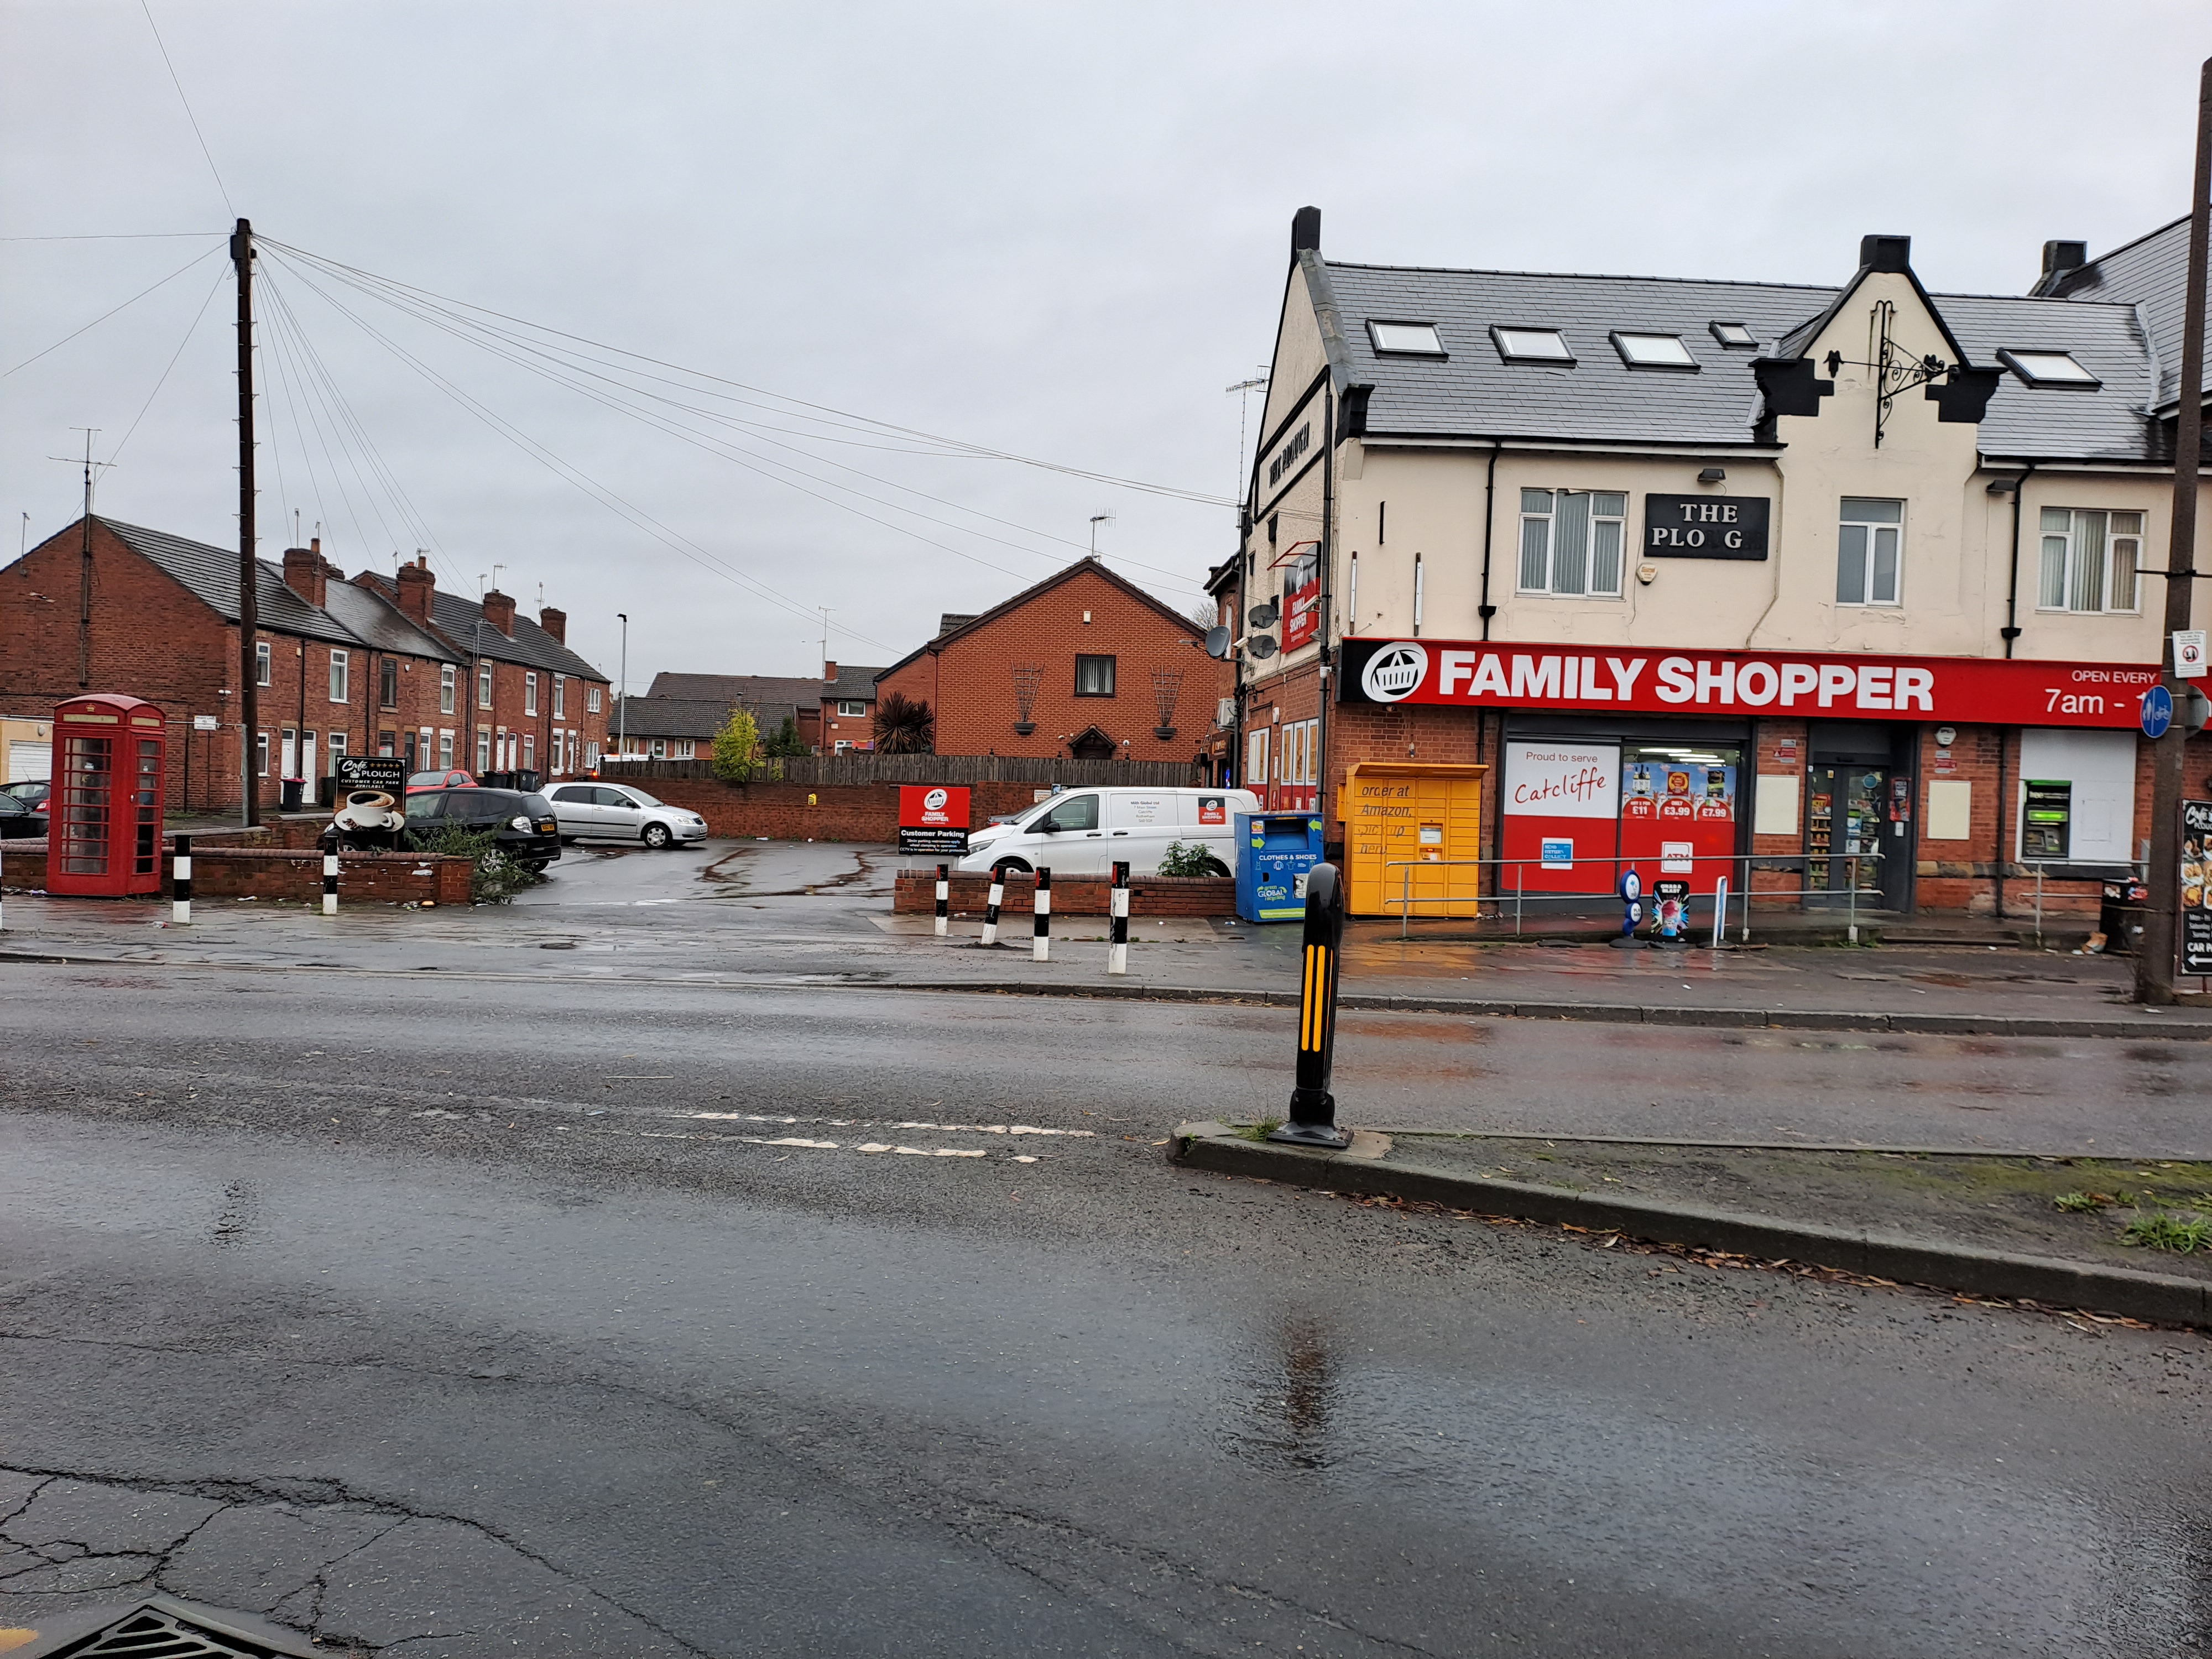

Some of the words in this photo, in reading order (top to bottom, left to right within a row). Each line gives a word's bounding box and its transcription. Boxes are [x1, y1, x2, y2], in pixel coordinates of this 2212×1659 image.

[1281, 420, 1310, 474] PLOUGH
[1269, 454, 1282, 489] THE
[1680, 504, 1738, 523] THE
[1290, 612, 1307, 634] SHOPPER
[1439, 650, 1647, 701] FAMILY
[1655, 656, 1934, 711] SHOPPER
[2072, 670, 2109, 682] OPEN
[2113, 671, 2157, 684] EVERY
[2045, 688, 2104, 714] 7am
[1526, 752, 1556, 761] Proud
[1559, 753, 1568, 762] to
[1397, 785, 1410, 797] at
[1515, 766, 1606, 804] Catcliffe
[1360, 804, 1412, 818] Amazon,
[1632, 806, 1648, 815] £11
[1664, 806, 1691, 816] £3.99
[1702, 808, 1726, 817] £7.99
[1258, 889, 1284, 898] GLOBAL
[2187, 942, 2205, 952] CAR
